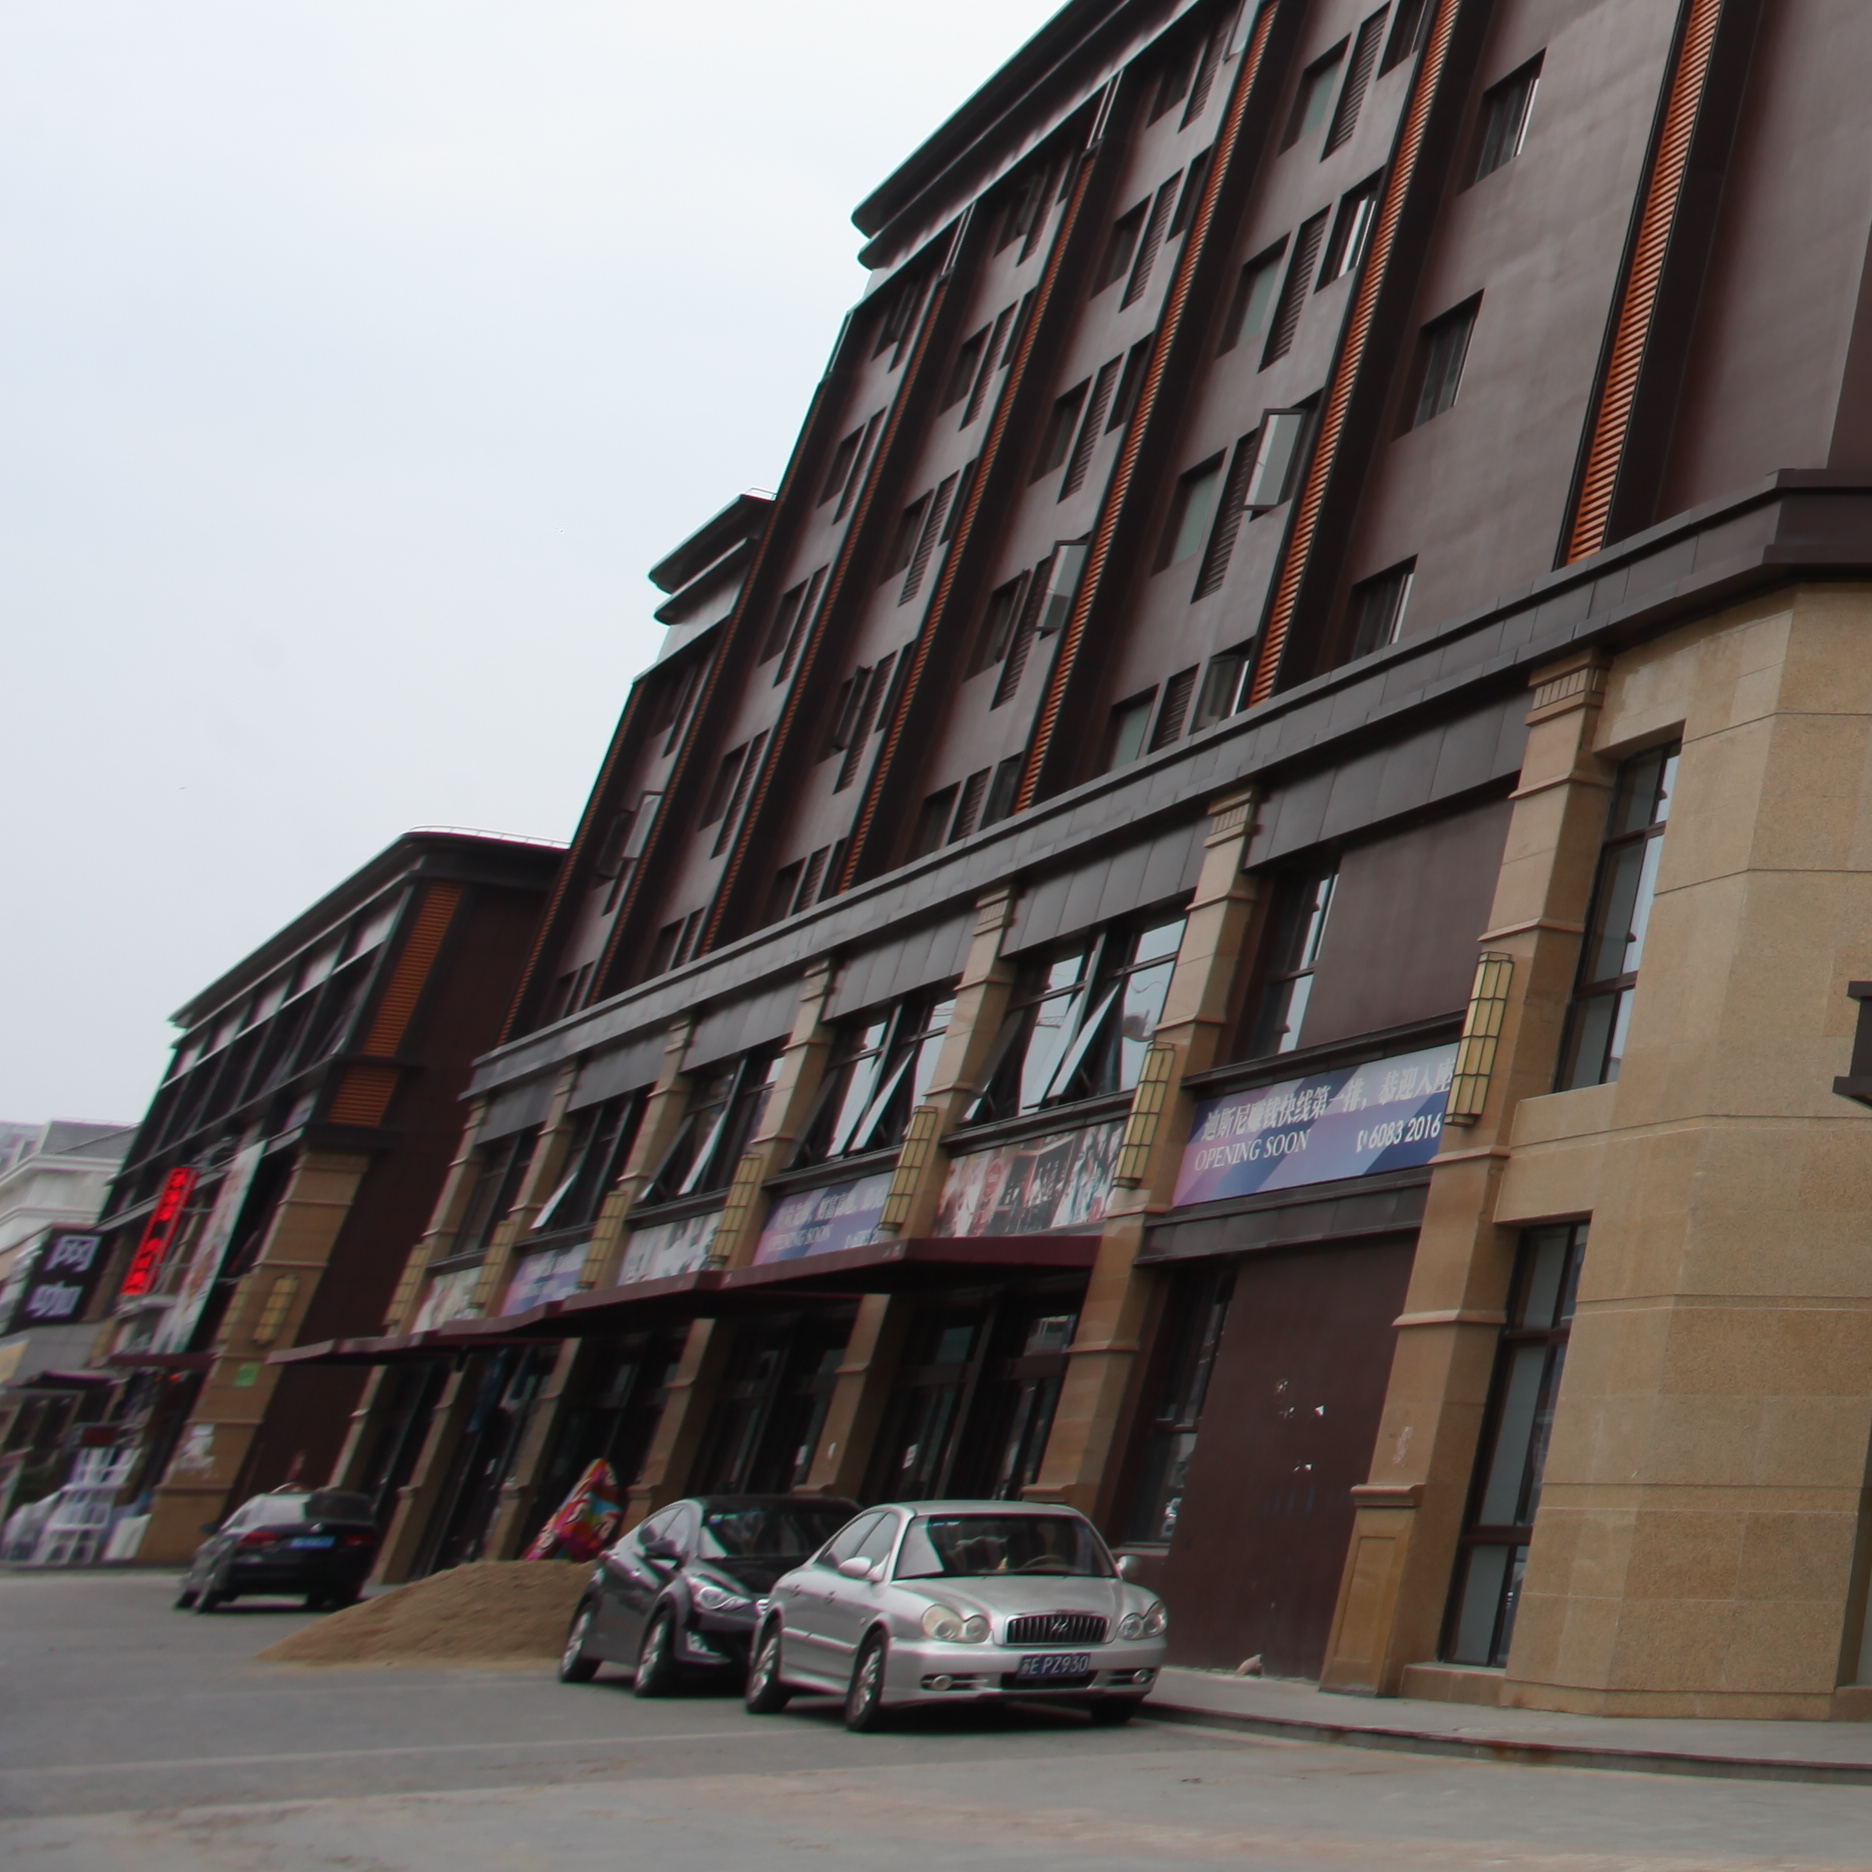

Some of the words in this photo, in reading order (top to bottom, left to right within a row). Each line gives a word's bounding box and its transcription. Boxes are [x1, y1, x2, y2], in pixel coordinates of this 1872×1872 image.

[1195, 1139, 1261, 1171] OPENING
[1263, 1128, 1312, 1159] SOON
[1368, 1120, 1404, 1151] 6083
[1404, 1112, 1443, 1143] 2016
